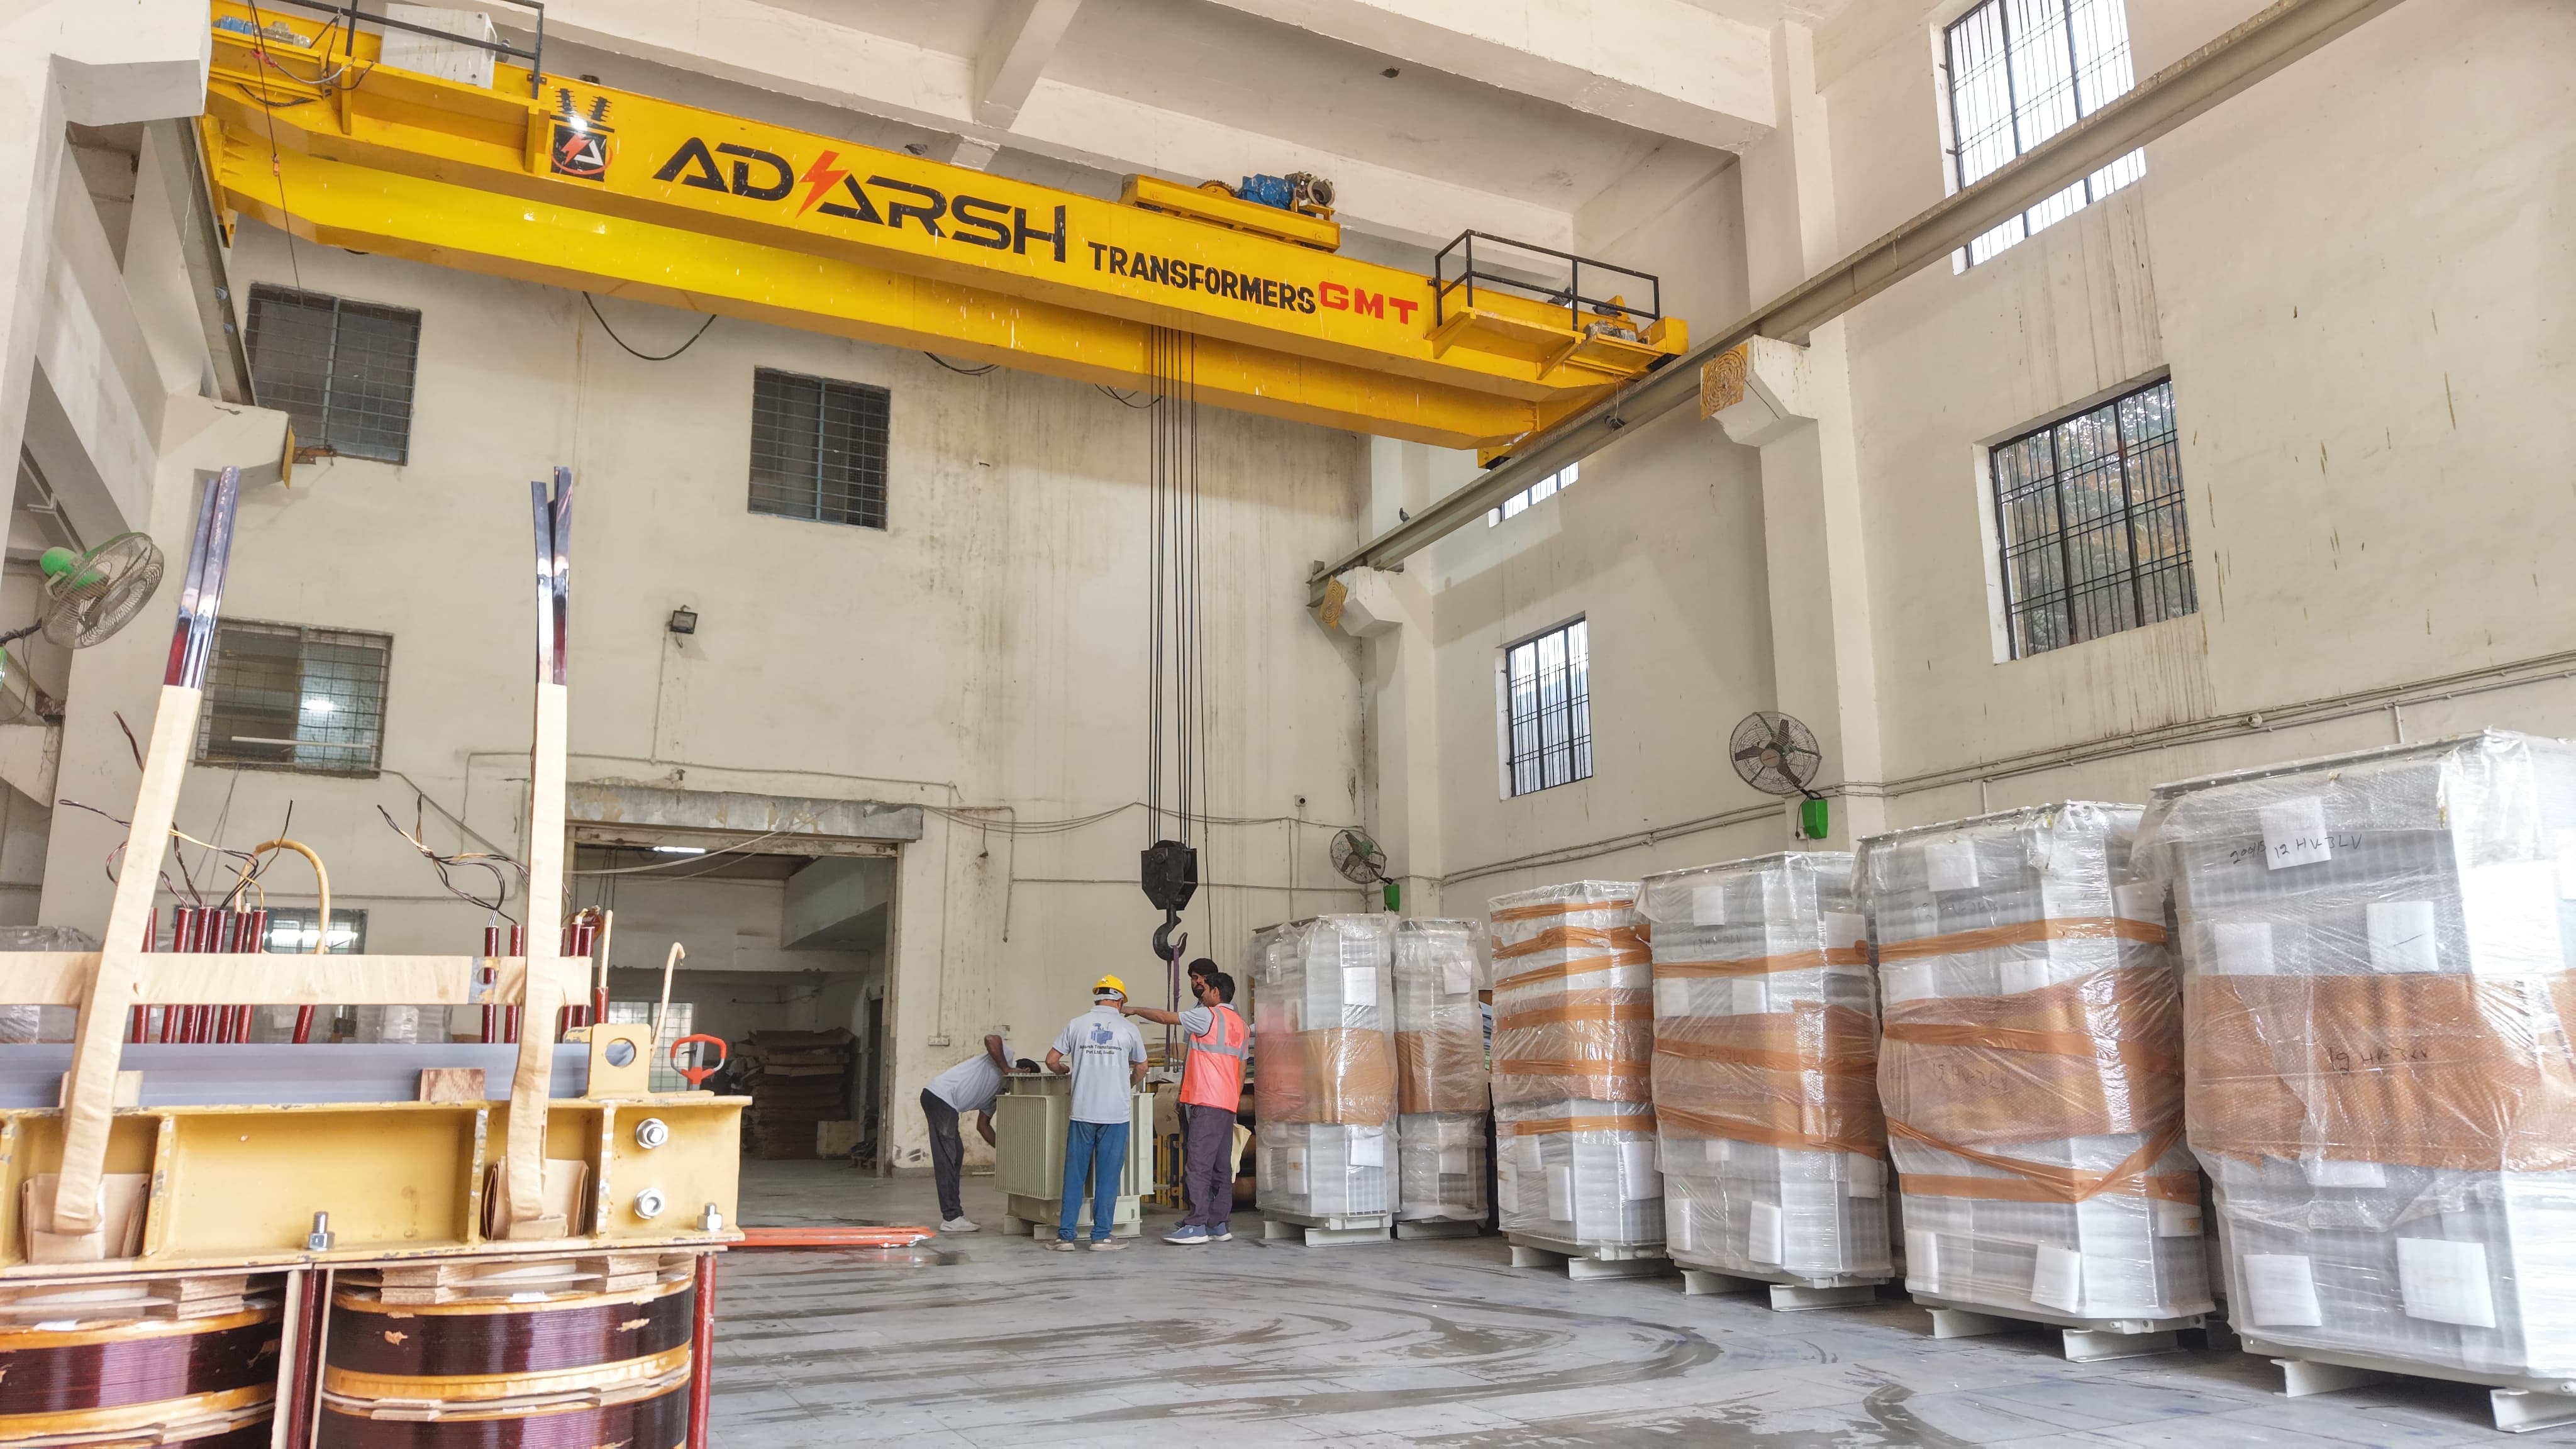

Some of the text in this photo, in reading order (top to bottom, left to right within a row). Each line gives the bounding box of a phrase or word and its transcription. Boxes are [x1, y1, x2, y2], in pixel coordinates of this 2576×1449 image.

[652, 136, 1316, 314] ADARSH TRANSFORMERS
[1318, 281, 1418, 325] GMT
[2274, 843, 2290, 858] 12
